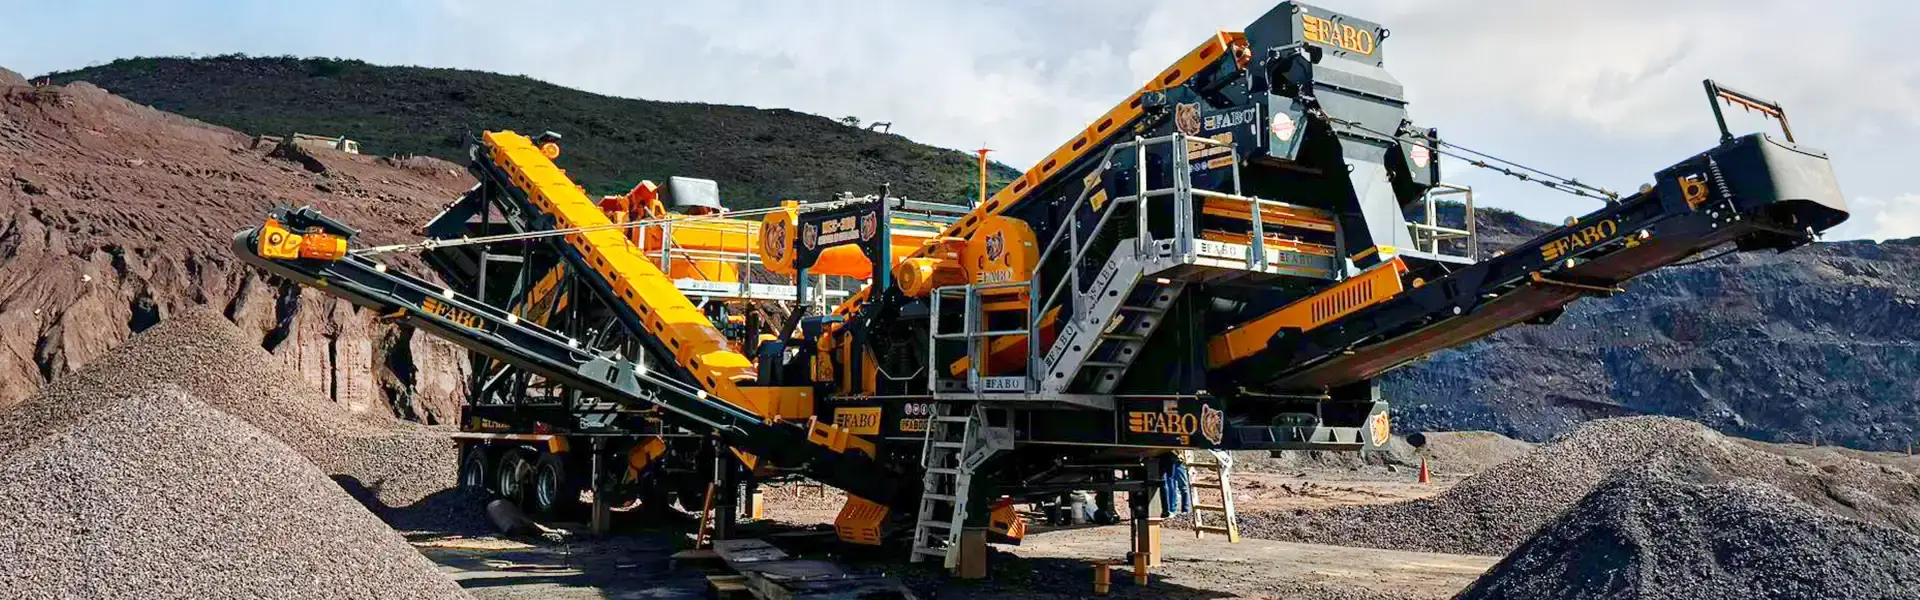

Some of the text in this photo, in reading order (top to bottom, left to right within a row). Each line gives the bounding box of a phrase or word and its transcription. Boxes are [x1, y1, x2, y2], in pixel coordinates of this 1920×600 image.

[1315, 17, 1374, 56] FABO
[1555, 219, 1616, 257] FABO
[433, 302, 485, 331] FABO
[1049, 326, 1075, 363] FABO
[991, 378, 1019, 389] FABO
[844, 413, 876, 429] FABO
[1140, 411, 1198, 436] FABO
